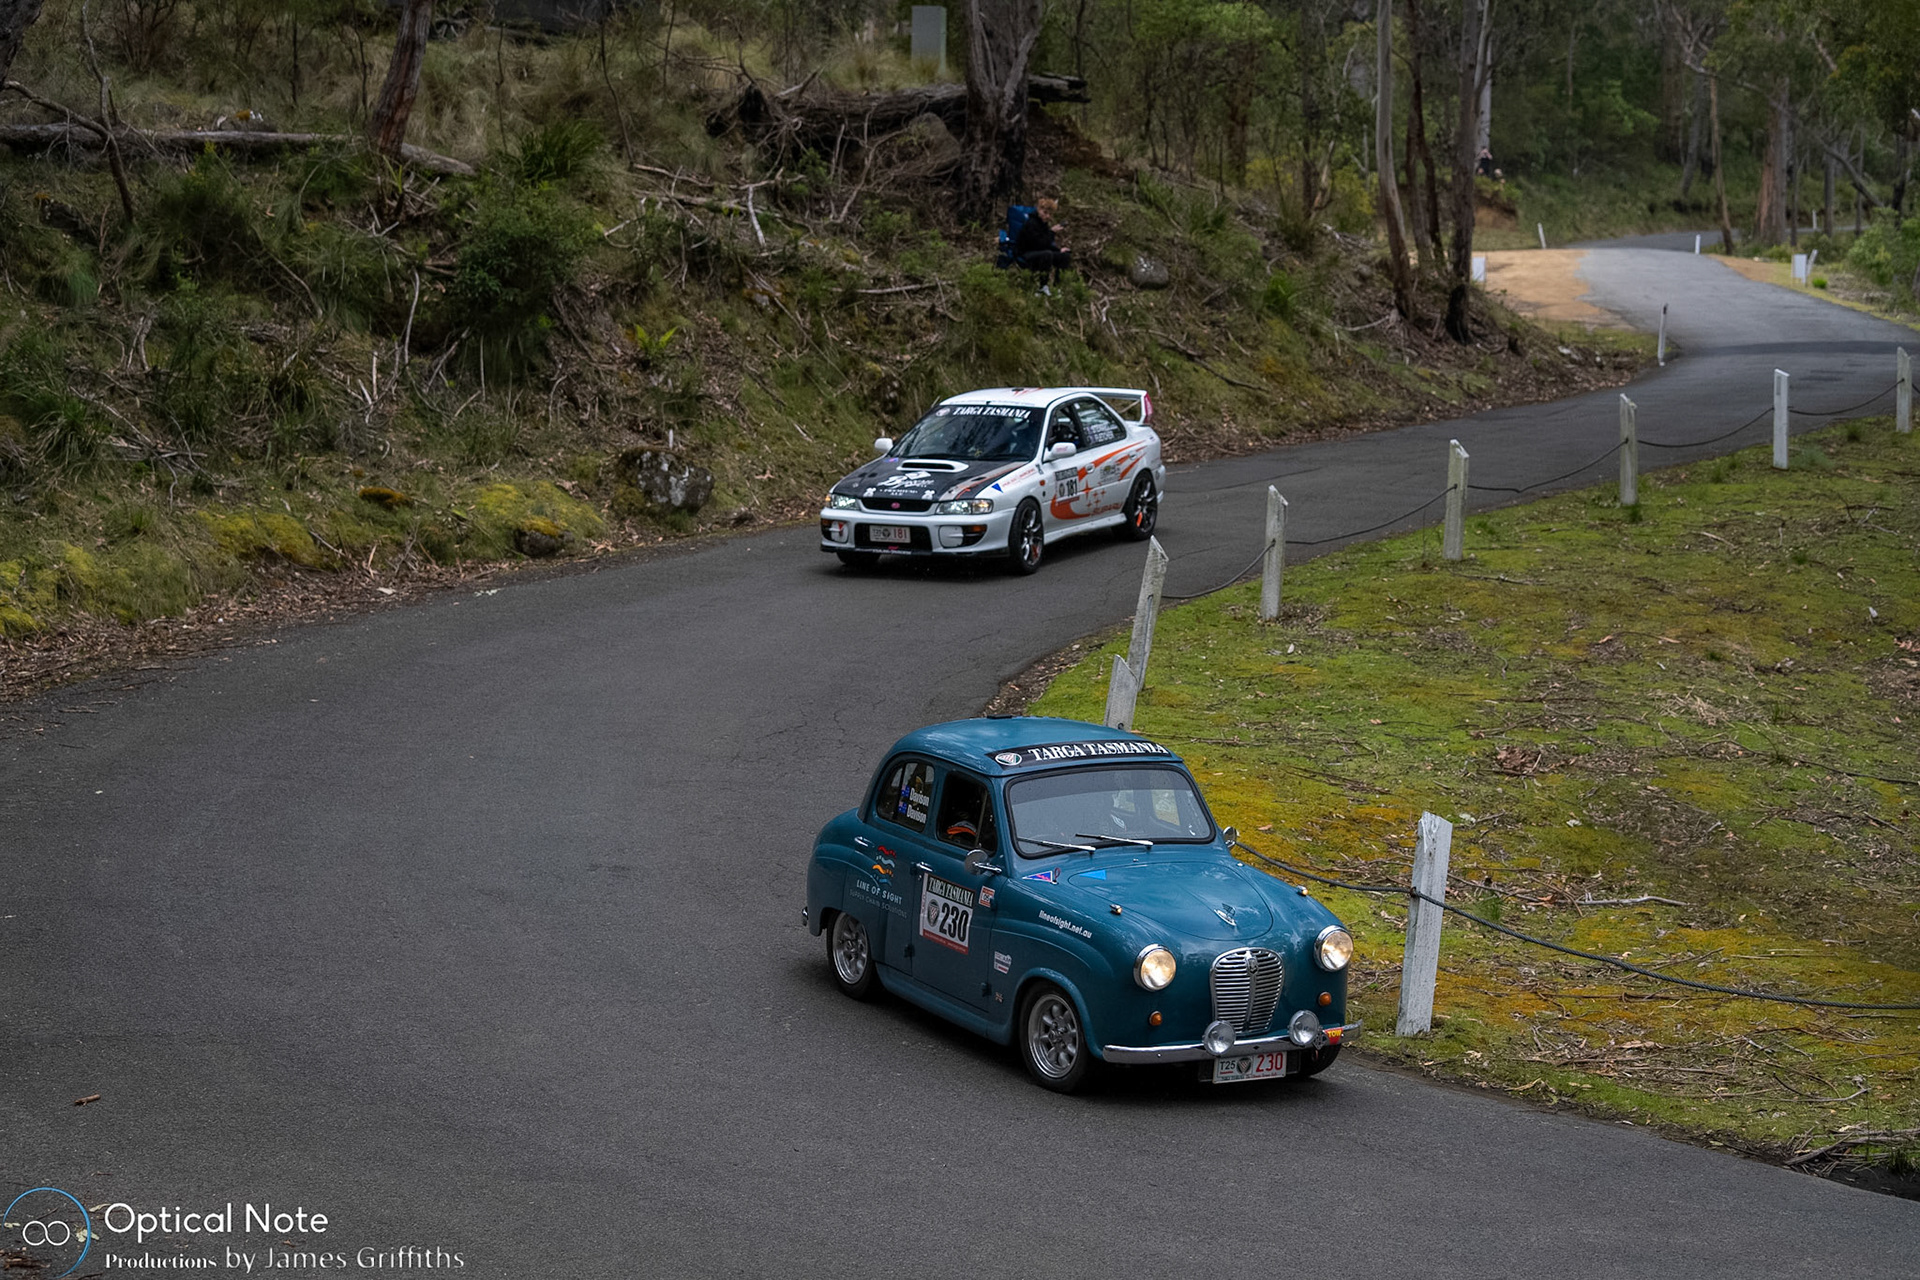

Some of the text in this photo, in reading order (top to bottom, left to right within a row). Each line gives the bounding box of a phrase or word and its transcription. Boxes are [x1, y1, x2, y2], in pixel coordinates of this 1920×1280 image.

[953, 406, 1031, 419] TARGA TASMANIA
[1066, 479, 1078, 497] 181
[894, 528, 907, 540] 181
[1028, 742, 1169, 762] TARGA TASMANIA
[910, 787, 930, 807] Davison
[906, 804, 927, 824] Davison
[856, 879, 903, 905] LINE OF SIGHT
[928, 877, 947, 896] TARGA
[945, 883, 974, 907] TASMANIA
[939, 902, 970, 942] 230
[1038, 909, 1093, 939] lineofsight.net.au
[1327, 1029, 1342, 1038] TOW
[1219, 1052, 1284, 1073] T25 230
